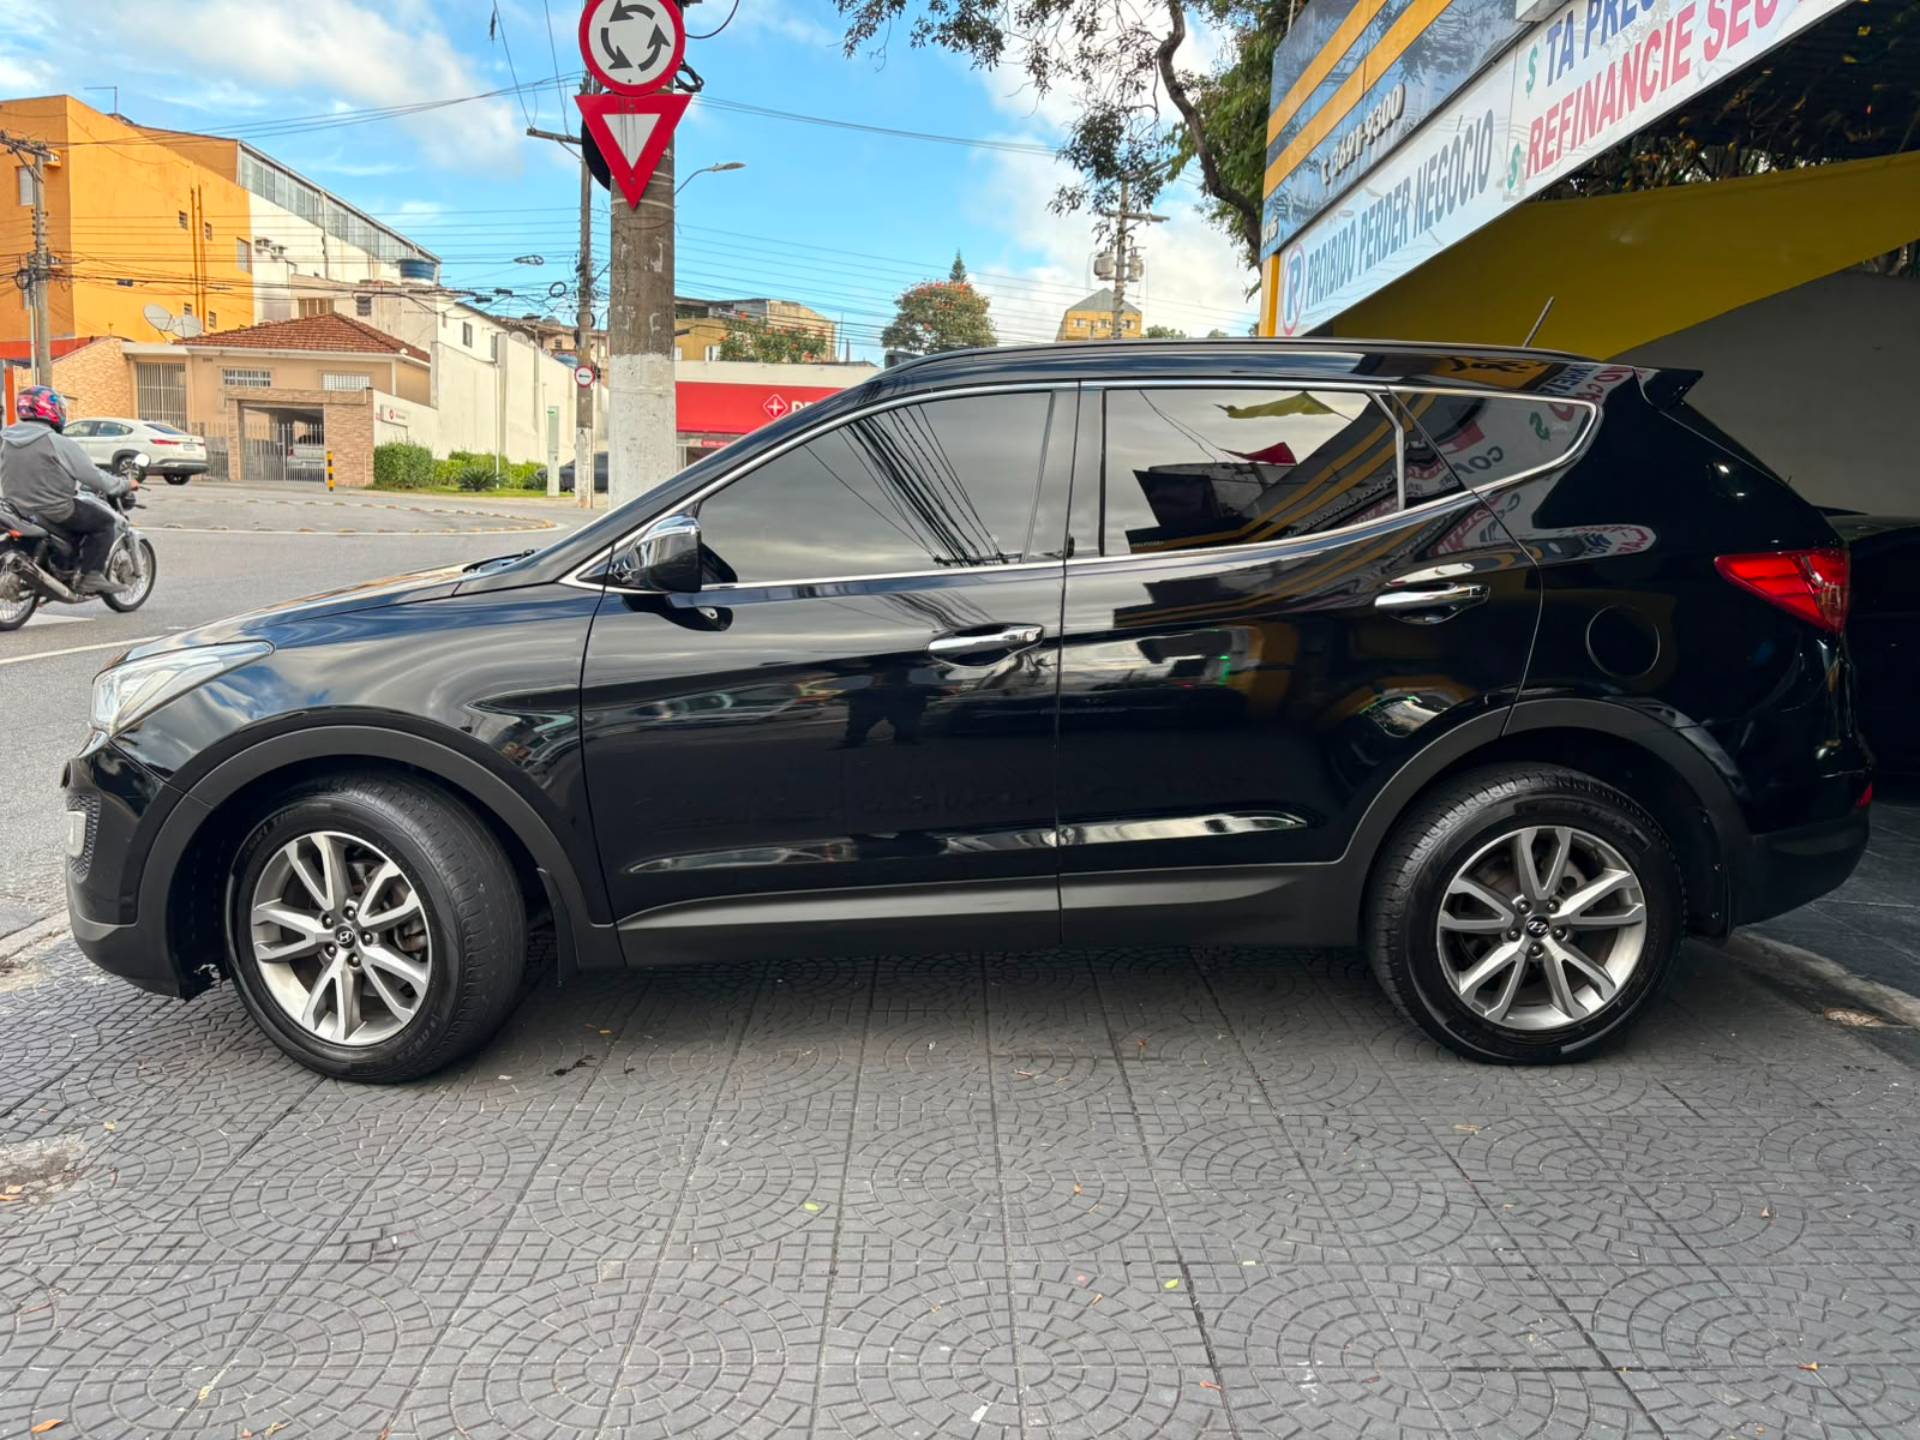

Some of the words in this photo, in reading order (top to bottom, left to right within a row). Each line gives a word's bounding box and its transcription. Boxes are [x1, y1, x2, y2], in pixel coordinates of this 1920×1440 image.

[1525, 2, 1697, 181] REFINANCIE
[1546, 9, 1575, 87] TA
[1306, 221, 1357, 310] PROIBIDO
[1357, 175, 1411, 276] PERDER
[1412, 109, 1495, 238] NEGÓCIO
